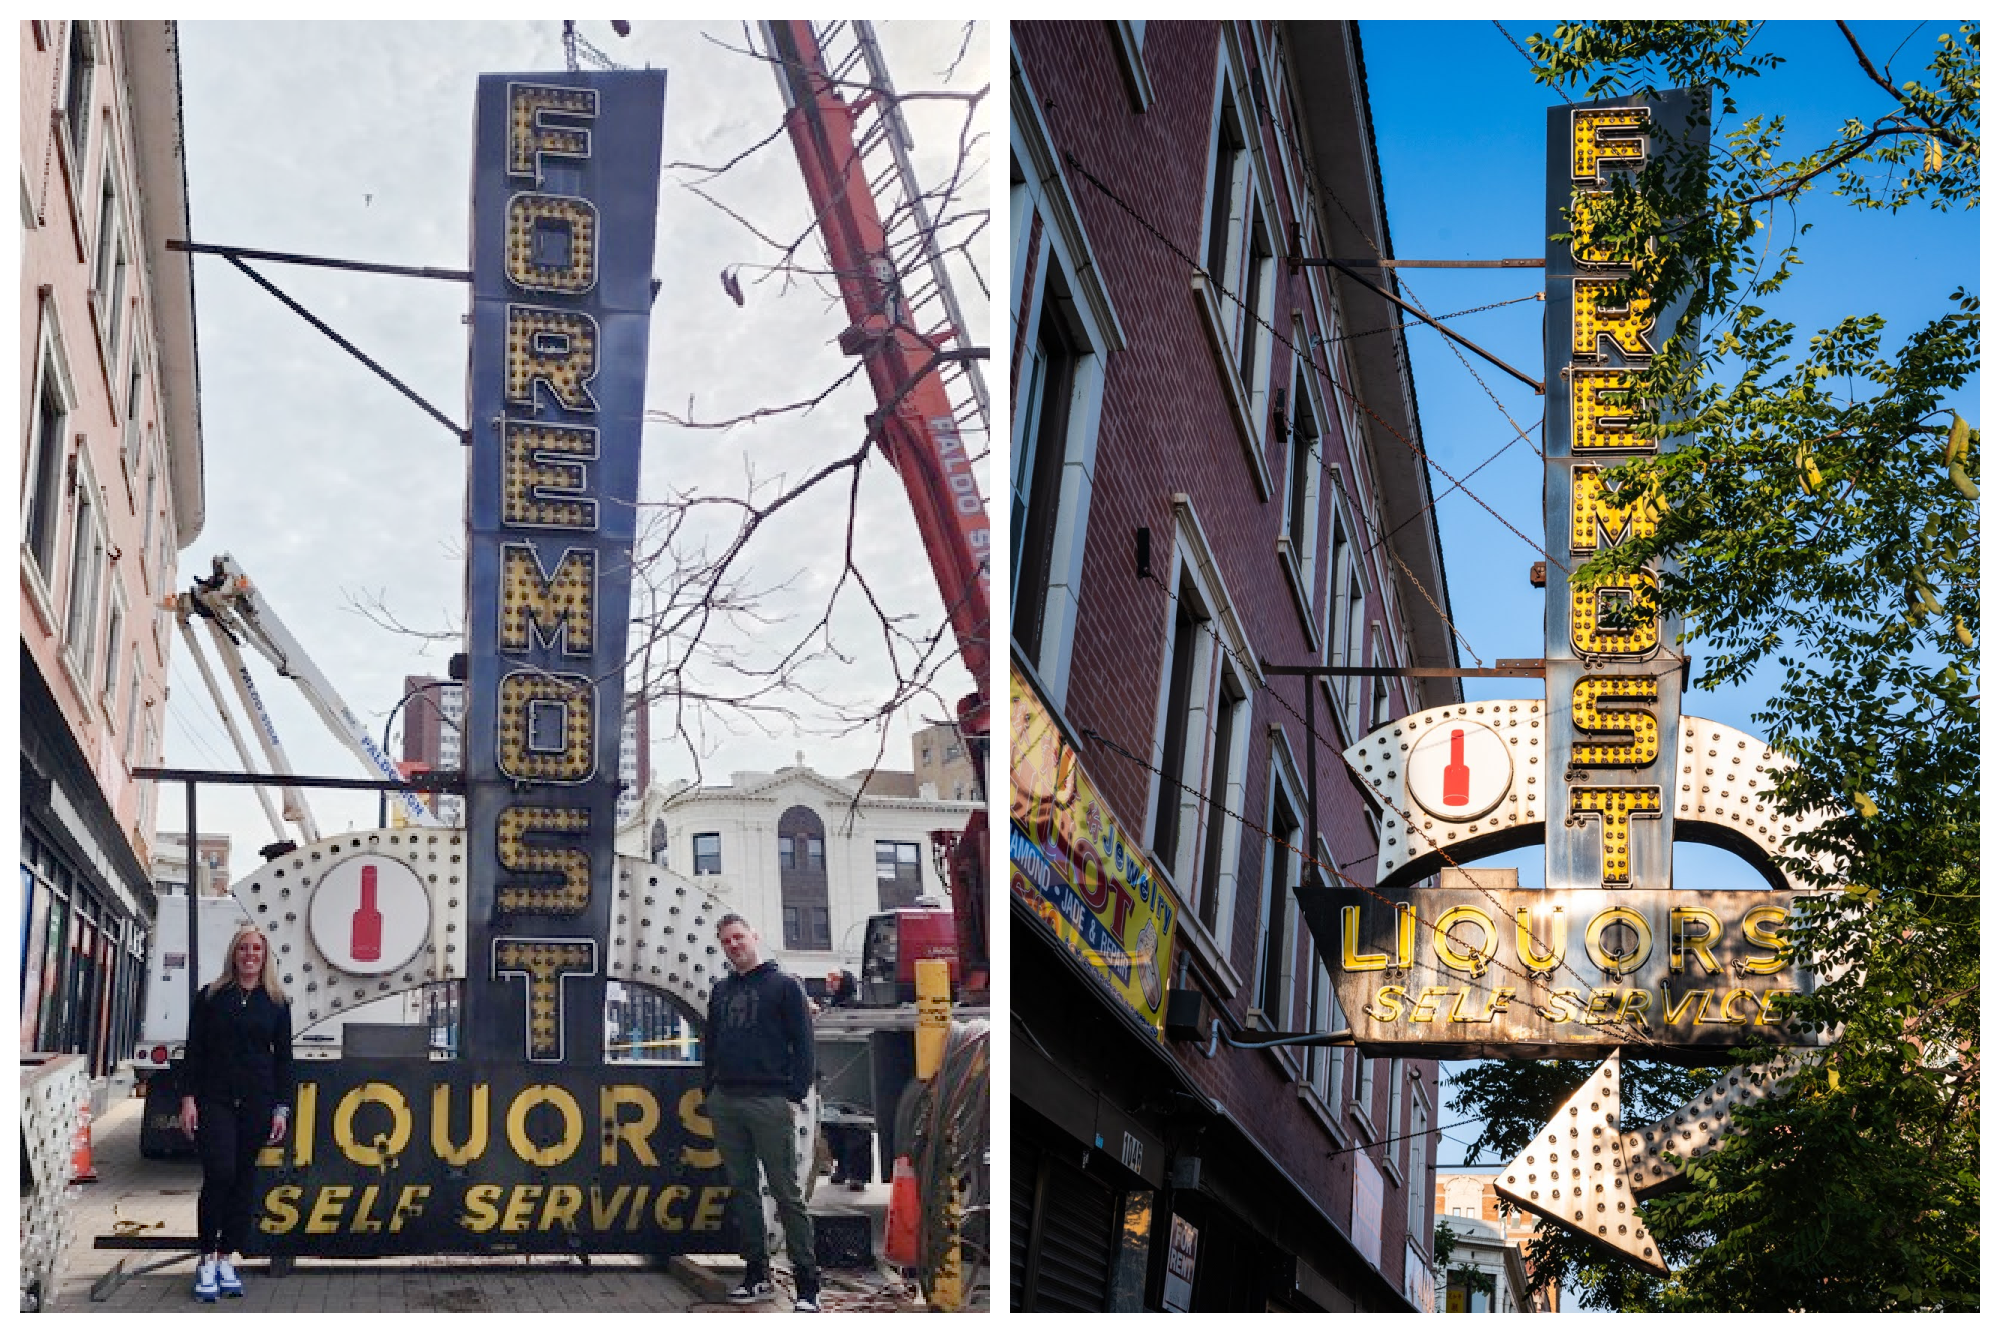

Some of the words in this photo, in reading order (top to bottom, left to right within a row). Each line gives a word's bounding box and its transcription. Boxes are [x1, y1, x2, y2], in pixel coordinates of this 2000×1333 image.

[930, 416, 982, 515] PALDO
[492, 82, 601, 1062] FOREMOST
[1103, 823, 1173, 935] Jewelry
[1061, 888, 1086, 931] JADE
[1088, 919, 1096, 945] &
[1100, 931, 1130, 980] REPAIR
[1341, 902, 1793, 976] LIQUORS
[1368, 985, 1516, 1023] SELF
[1542, 987, 1793, 1026] SERVICE
[255, 1082, 725, 1170] IQUORS
[259, 1185, 432, 1234] SELF
[460, 1184, 733, 1232] SERVICE
[1174, 1221, 1194, 1256] FOR
[1170, 1247, 1194, 1280] RENT
